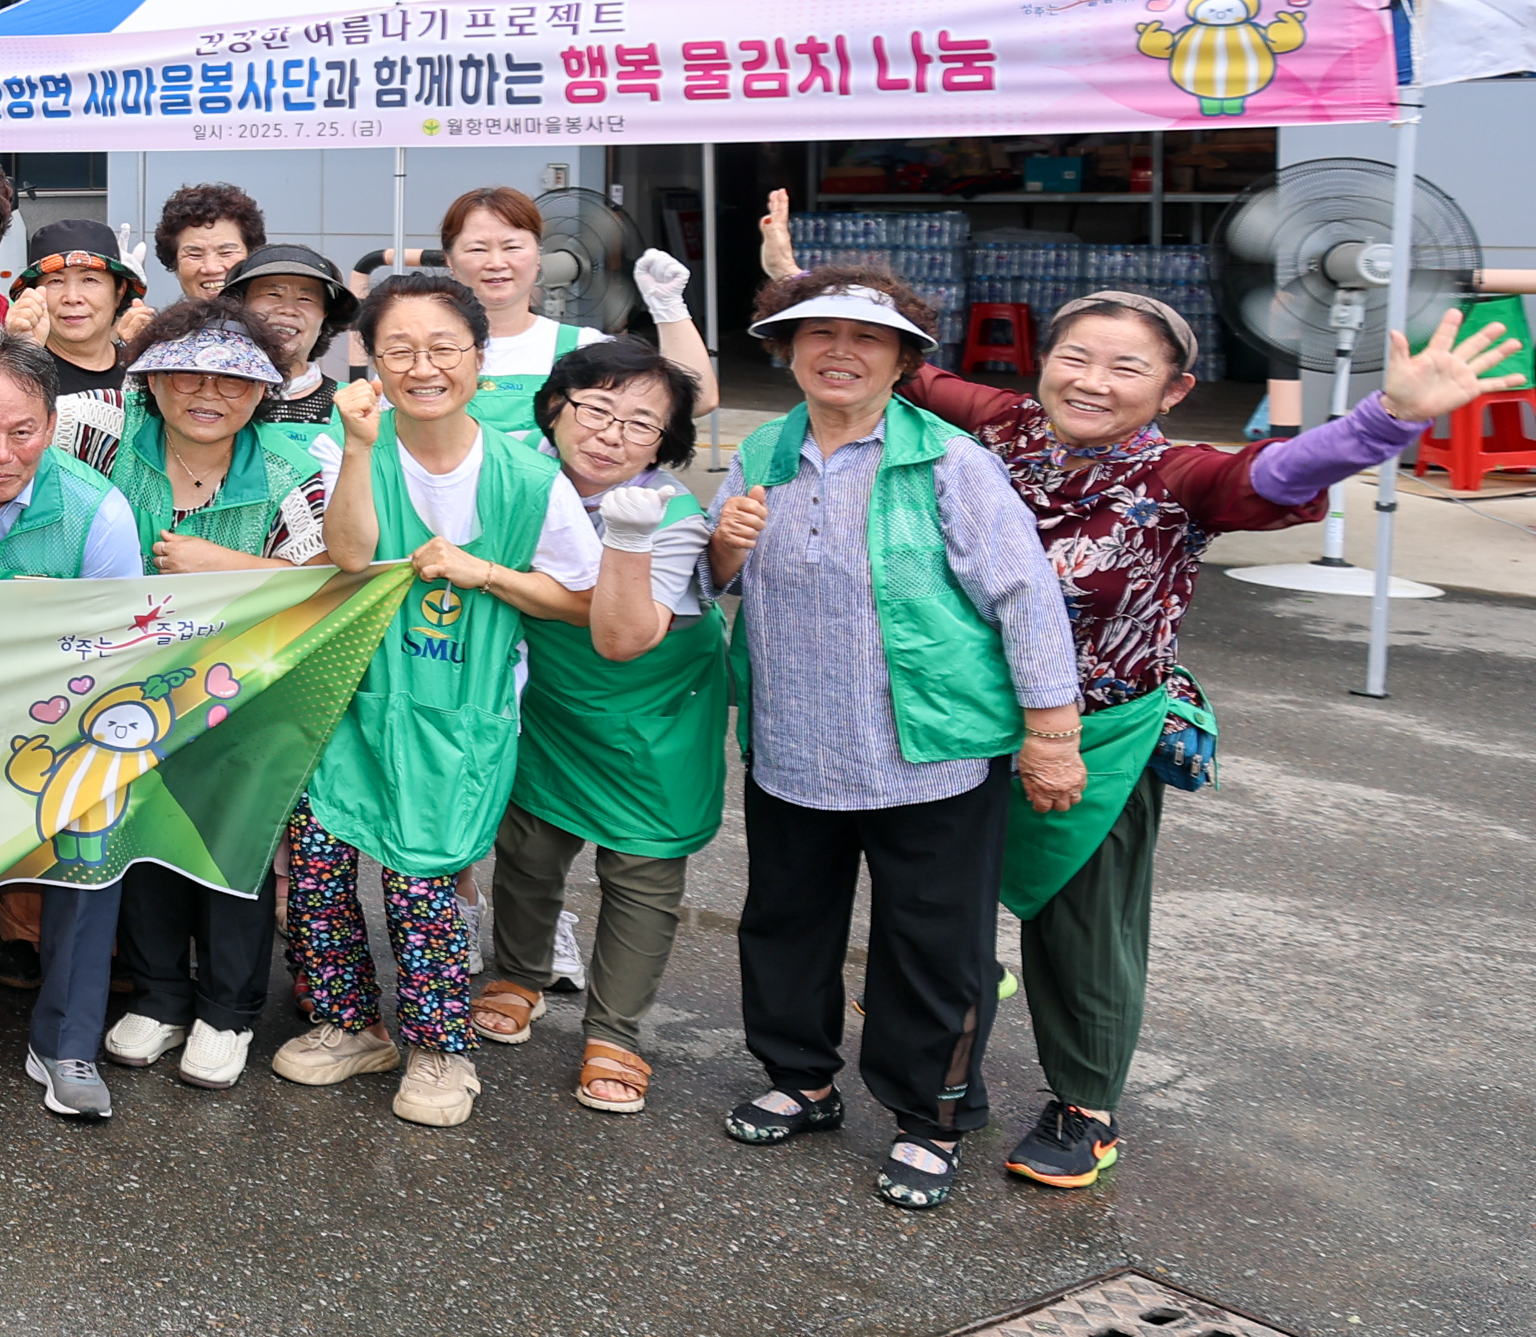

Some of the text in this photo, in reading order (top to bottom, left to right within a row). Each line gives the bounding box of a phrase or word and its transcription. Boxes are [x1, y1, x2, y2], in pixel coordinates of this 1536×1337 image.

[304, 6, 449, 47] 여름나기
[463, 1, 627, 38] 프로젝트
[83, 56, 360, 117] 새마을봉사단과
[374, 52, 543, 108] 함께하는
[560, 42, 663, 104] 행복
[682, 34, 851, 101] 물김치
[873, 29, 997, 94] 나눔
[237, 123, 288, 140] 2025.
[446, 115, 626, 137] 월항면새마을봉사단
[57, 620, 224, 661] 성주는 즐겁다!
[402, 631, 466, 663] SMU
